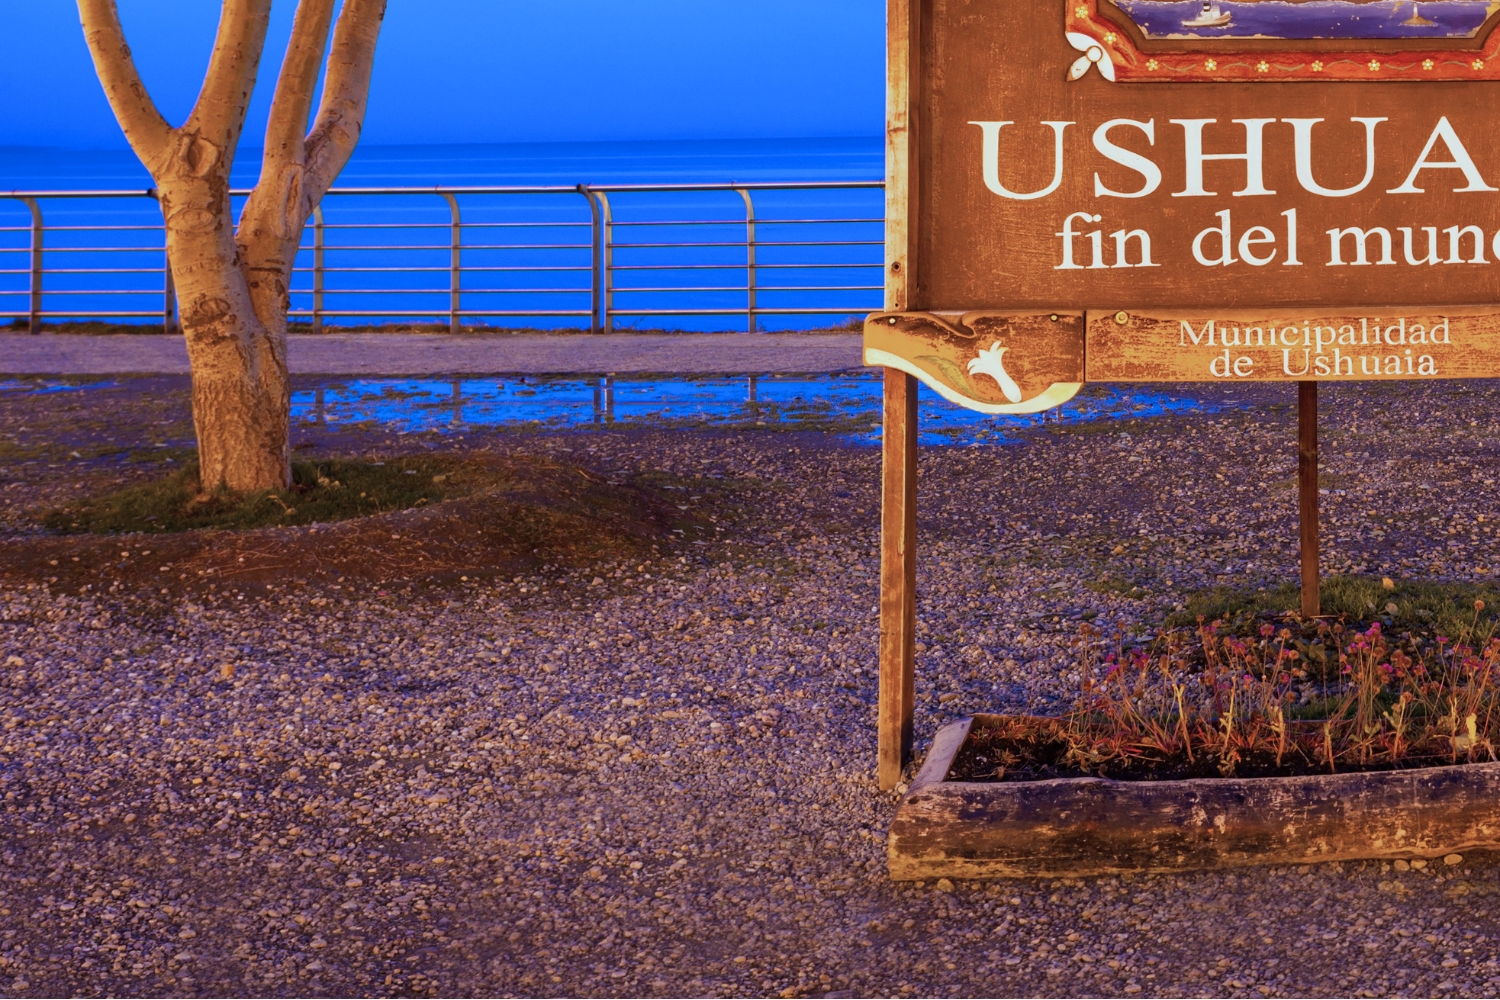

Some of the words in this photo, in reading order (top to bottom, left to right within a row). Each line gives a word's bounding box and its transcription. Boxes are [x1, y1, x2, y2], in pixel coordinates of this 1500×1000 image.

[1053, 211, 1161, 270] fin
[1191, 207, 1303, 267] del
[1179, 318, 1452, 354] Municipalidad
[1209, 349, 1254, 377] de
[1280, 348, 1439, 377] Ushuaia
